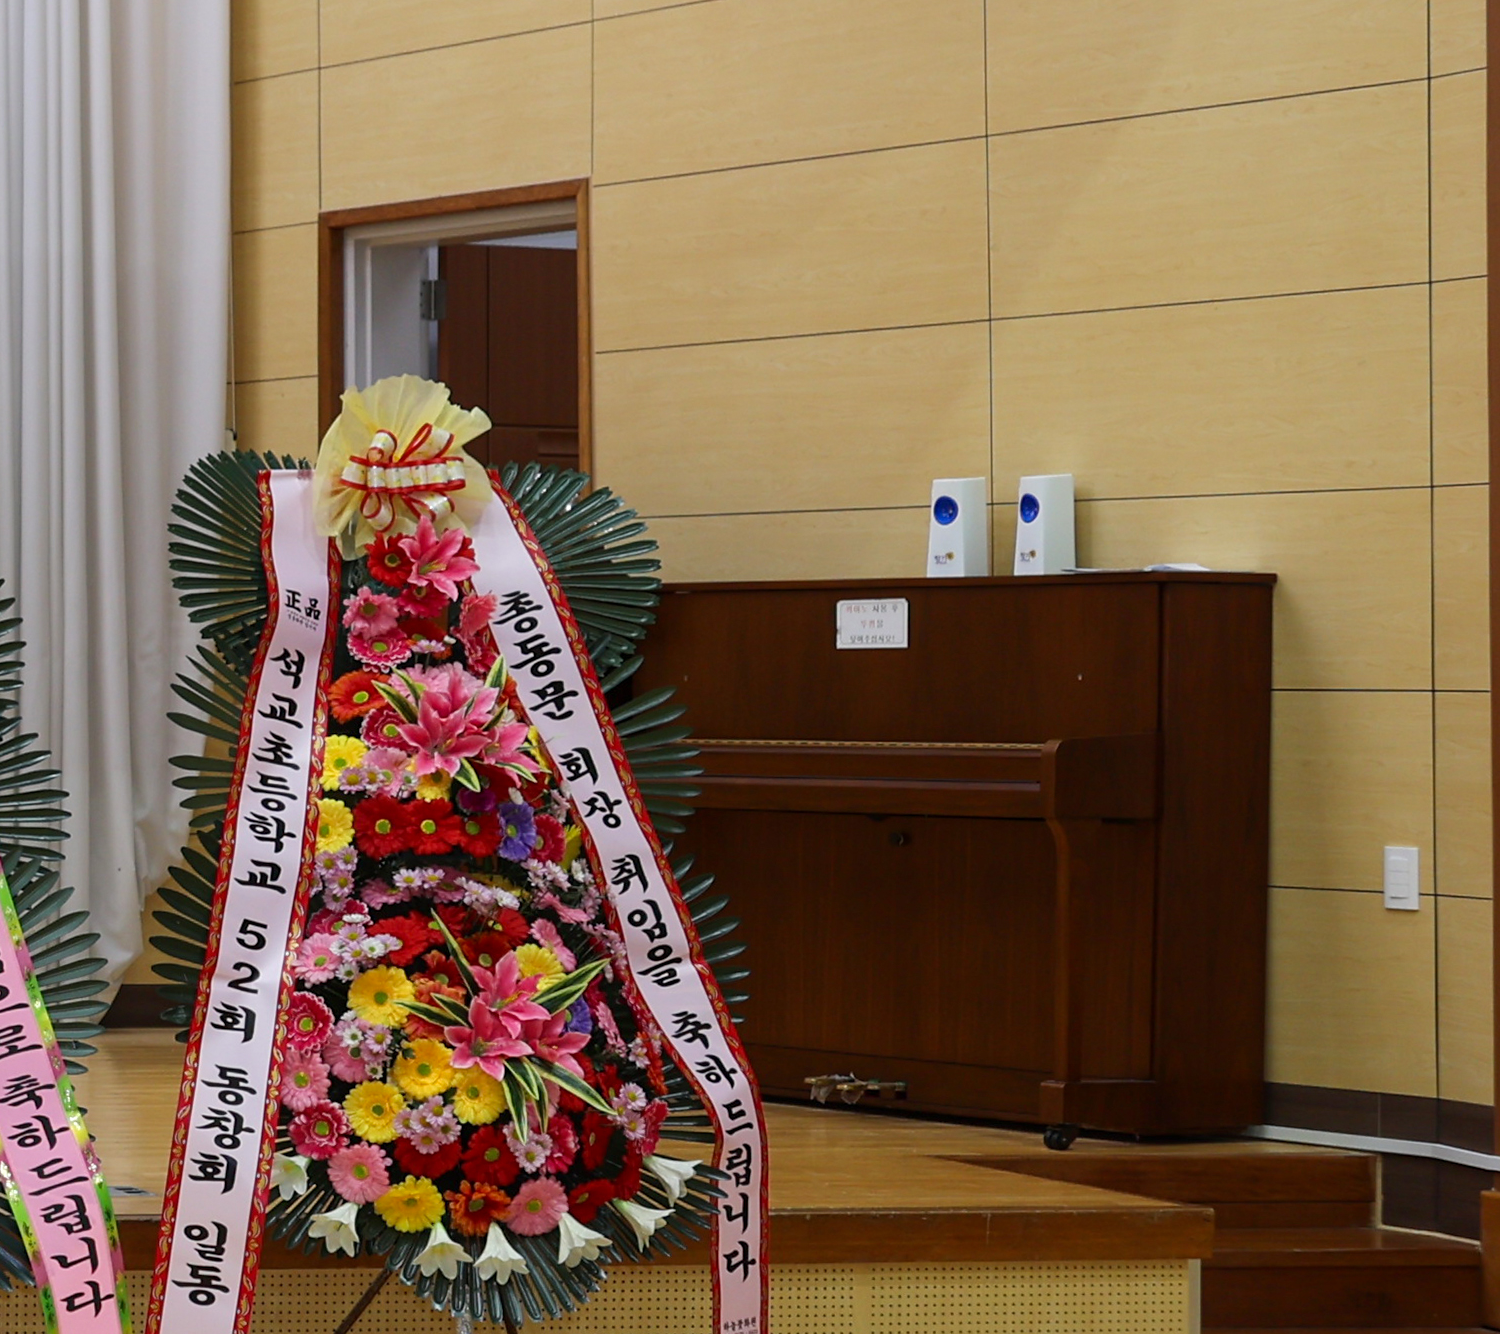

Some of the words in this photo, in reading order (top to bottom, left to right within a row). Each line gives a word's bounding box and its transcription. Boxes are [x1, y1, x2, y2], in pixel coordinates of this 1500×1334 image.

[284, 588, 321, 621] 正品
[234, 647, 306, 895] 석교초등학교
[210, 918, 269, 1044] 52회
[188, 1063, 257, 1195] 동창회
[610, 853, 684, 988] 취임을
[671, 1010, 757, 1283] 축하드립니다
[172, 1220, 231, 1306] 일동
